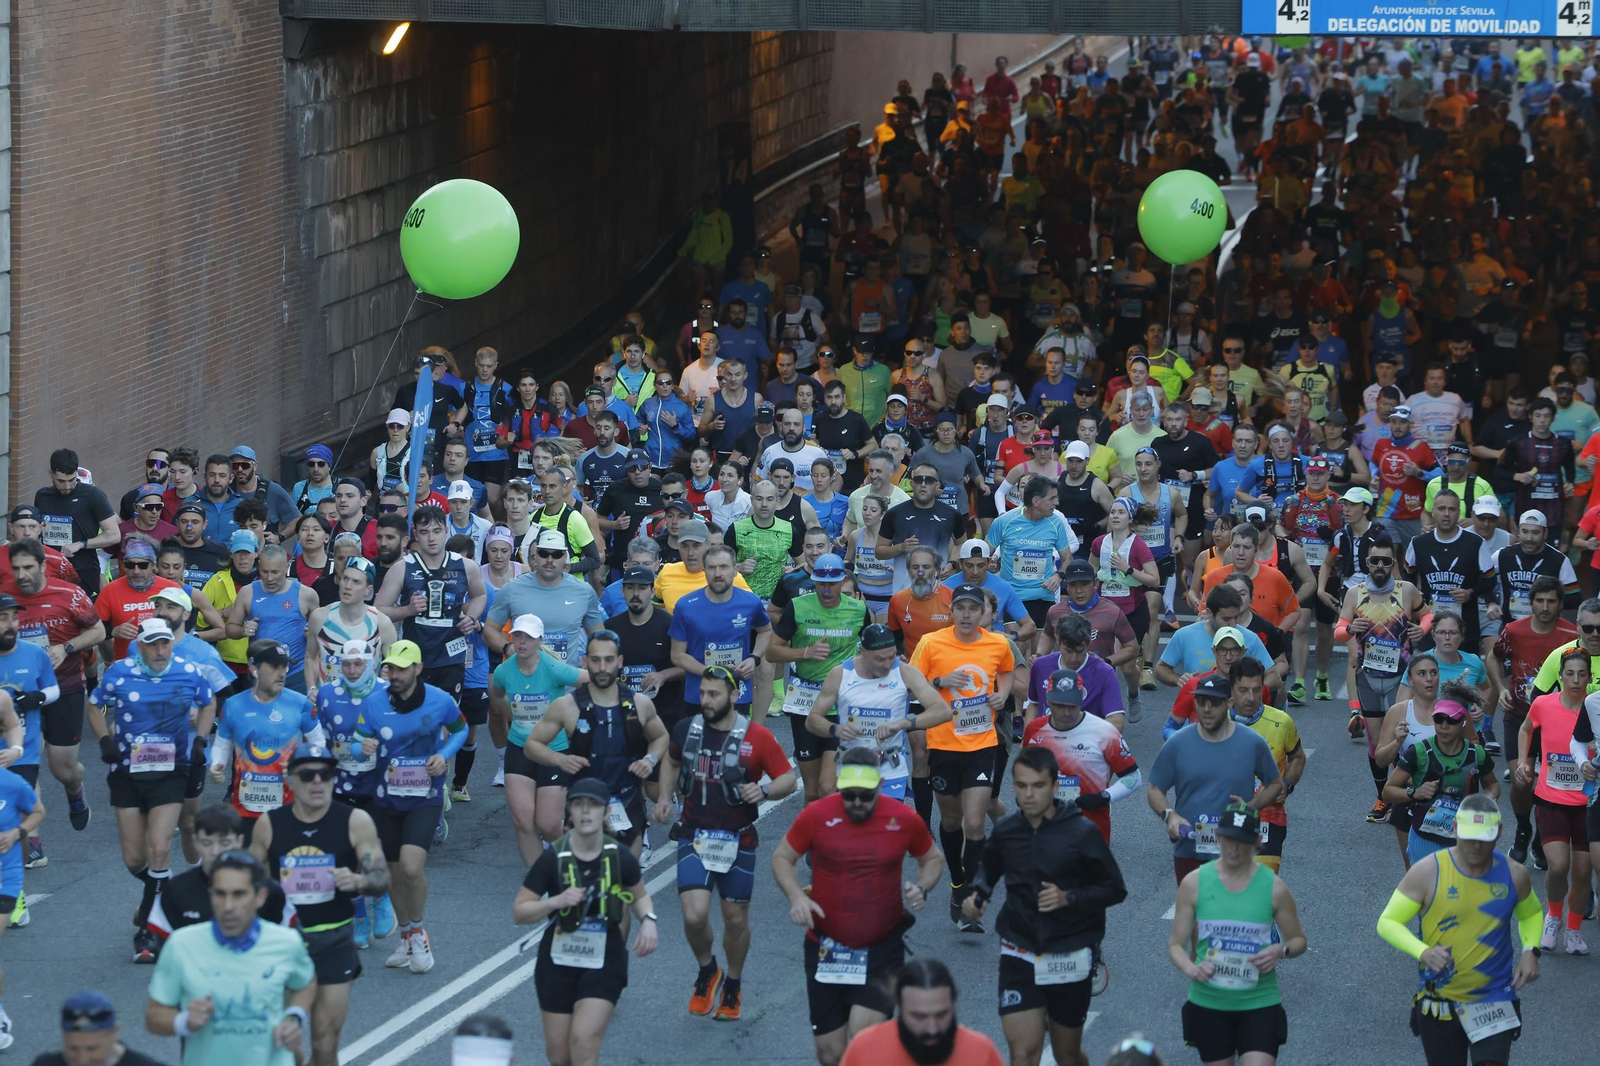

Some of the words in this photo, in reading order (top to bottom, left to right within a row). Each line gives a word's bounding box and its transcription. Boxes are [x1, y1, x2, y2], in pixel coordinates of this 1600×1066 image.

[1372, 6, 1444, 16] AYUNTAMIENTO
[1446, 7, 1458, 15] DE
[1460, 6, 1496, 16] SEVILLA
[1328, 16, 1426, 33] DELEGACIÓN
[1430, 19, 1451, 33] DE
[1455, 19, 1542, 34] MOVILIDAD
[1189, 198, 1213, 220] 4:00
[1425, 571, 1466, 584] KENIATAS
[806, 628, 825, 636] MEDIO
[826, 628, 852, 637] MARATÓN
[1367, 652, 1384, 662] IÑAKI
[1385, 656, 1395, 664] GA
[794, 698, 813, 708] JULIO
[965, 697, 986, 706] ZURICH
[960, 715, 986, 727] QUIQUE
[136, 754, 168, 763] CARLOS
[1555, 772, 1578, 781] ROCIO
[387, 778, 431, 787] ALEJANDRO
[244, 793, 277, 802] BERANA
[710, 832, 735, 840] ZURICH
[1205, 922, 1260, 936] Compton
[562, 943, 595, 956] SARAH
[1225, 942, 1254, 952] ZURICH
[1047, 961, 1076, 972] SERGI
[1472, 1008, 1505, 1027] TOVAR
